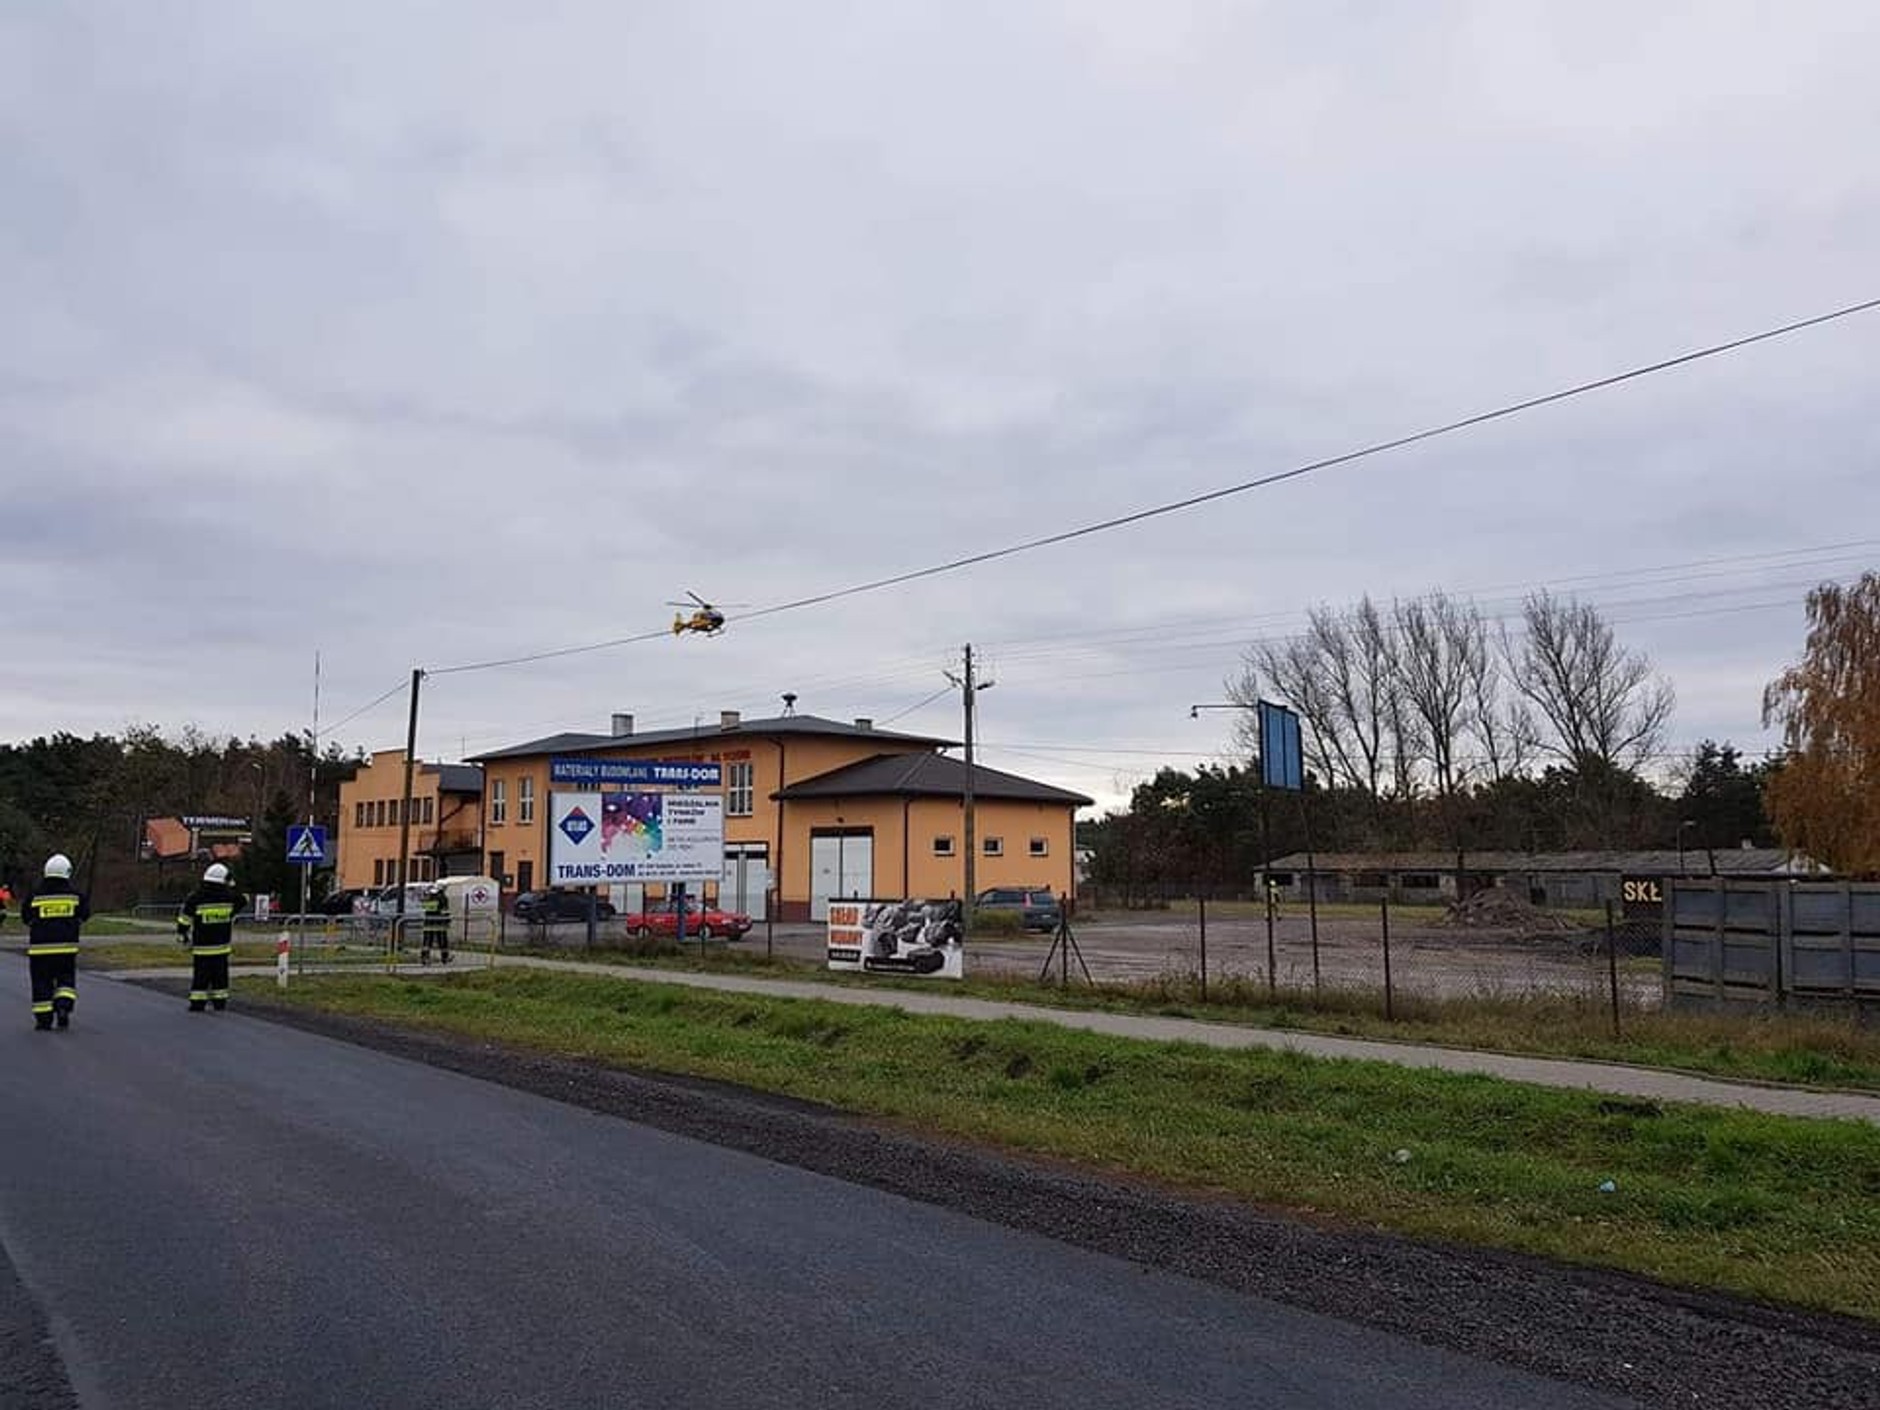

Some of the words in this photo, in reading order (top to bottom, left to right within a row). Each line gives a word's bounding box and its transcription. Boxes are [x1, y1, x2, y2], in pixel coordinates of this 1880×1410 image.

[654, 767, 719, 780] TRANS-DOM
[558, 863, 635, 878] TRANS-DOM
[1623, 881, 1662, 901] SKŁ
